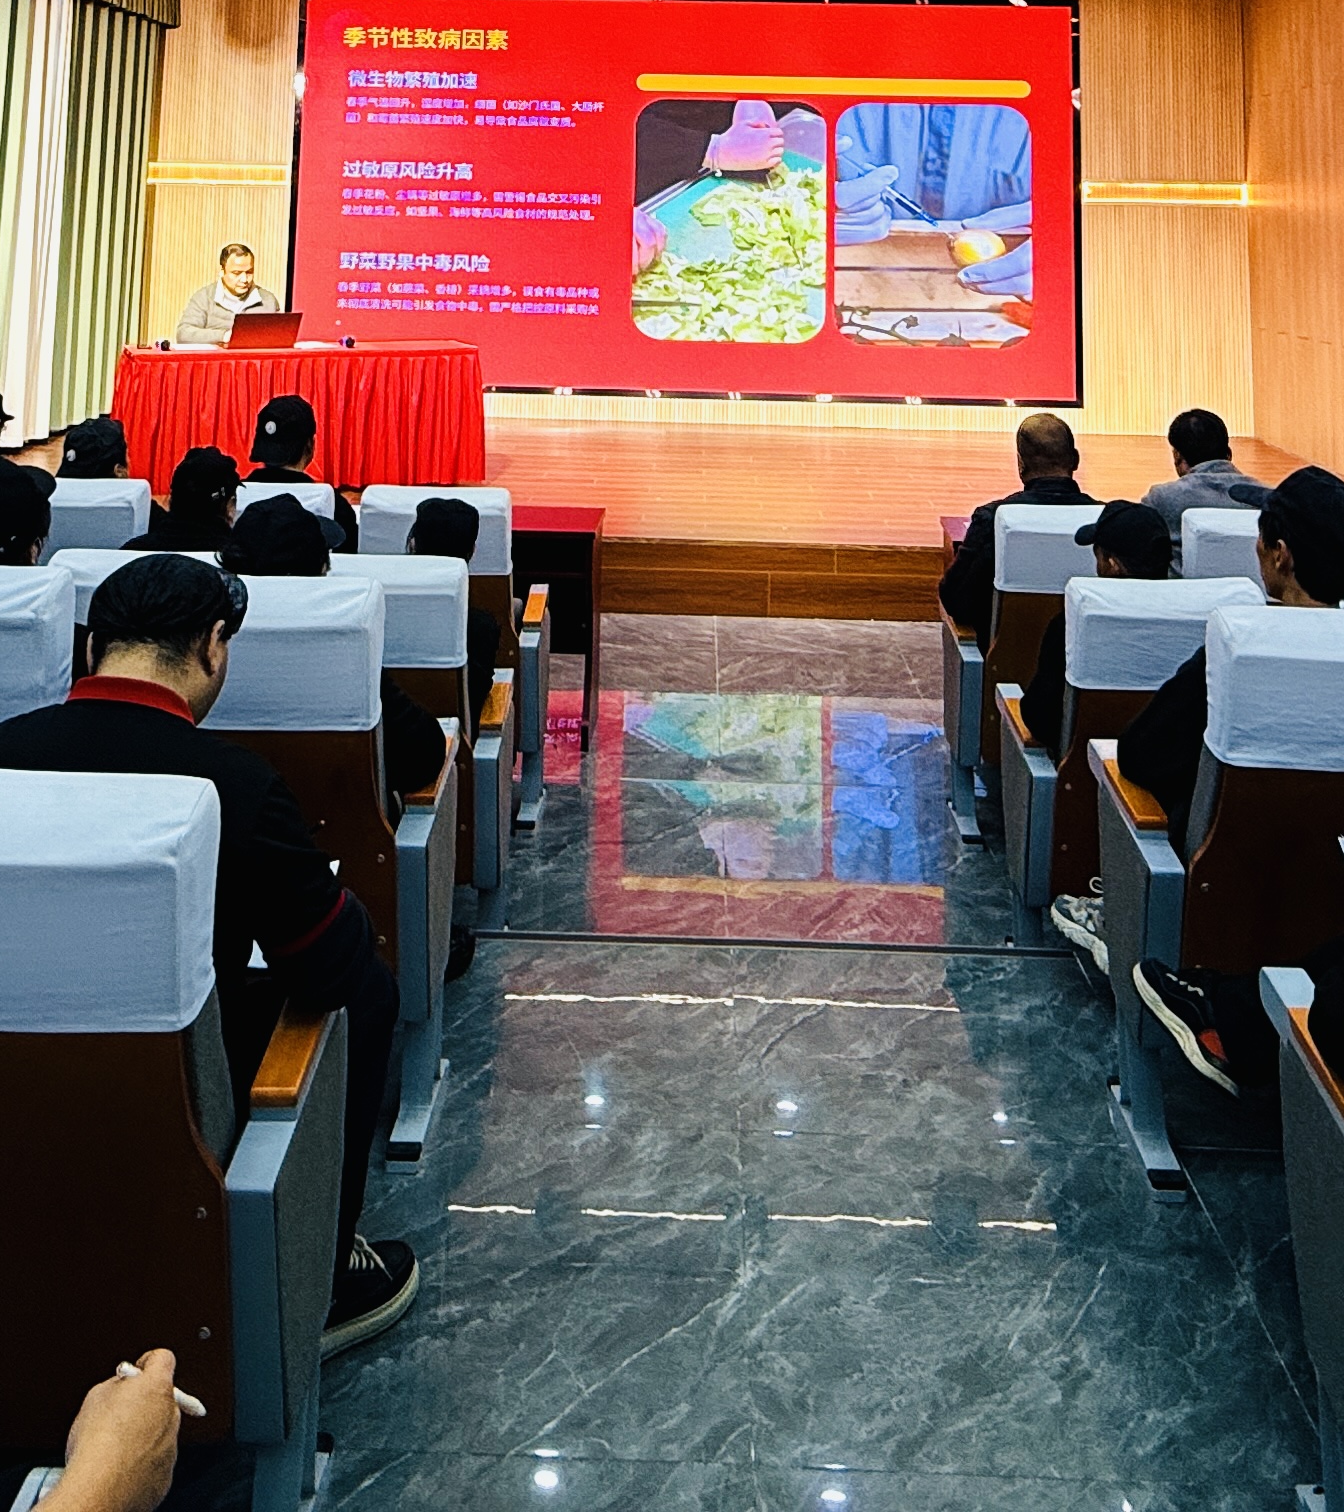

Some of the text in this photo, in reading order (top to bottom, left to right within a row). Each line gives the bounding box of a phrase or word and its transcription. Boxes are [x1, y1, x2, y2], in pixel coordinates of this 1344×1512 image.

[343, 26, 508, 50] 季节性致病因素
[348, 69, 478, 89] 微生物繁殖加速
[342, 160, 473, 180] 过敏原风险升高
[339, 251, 490, 273] 野菜野果中毒风险
